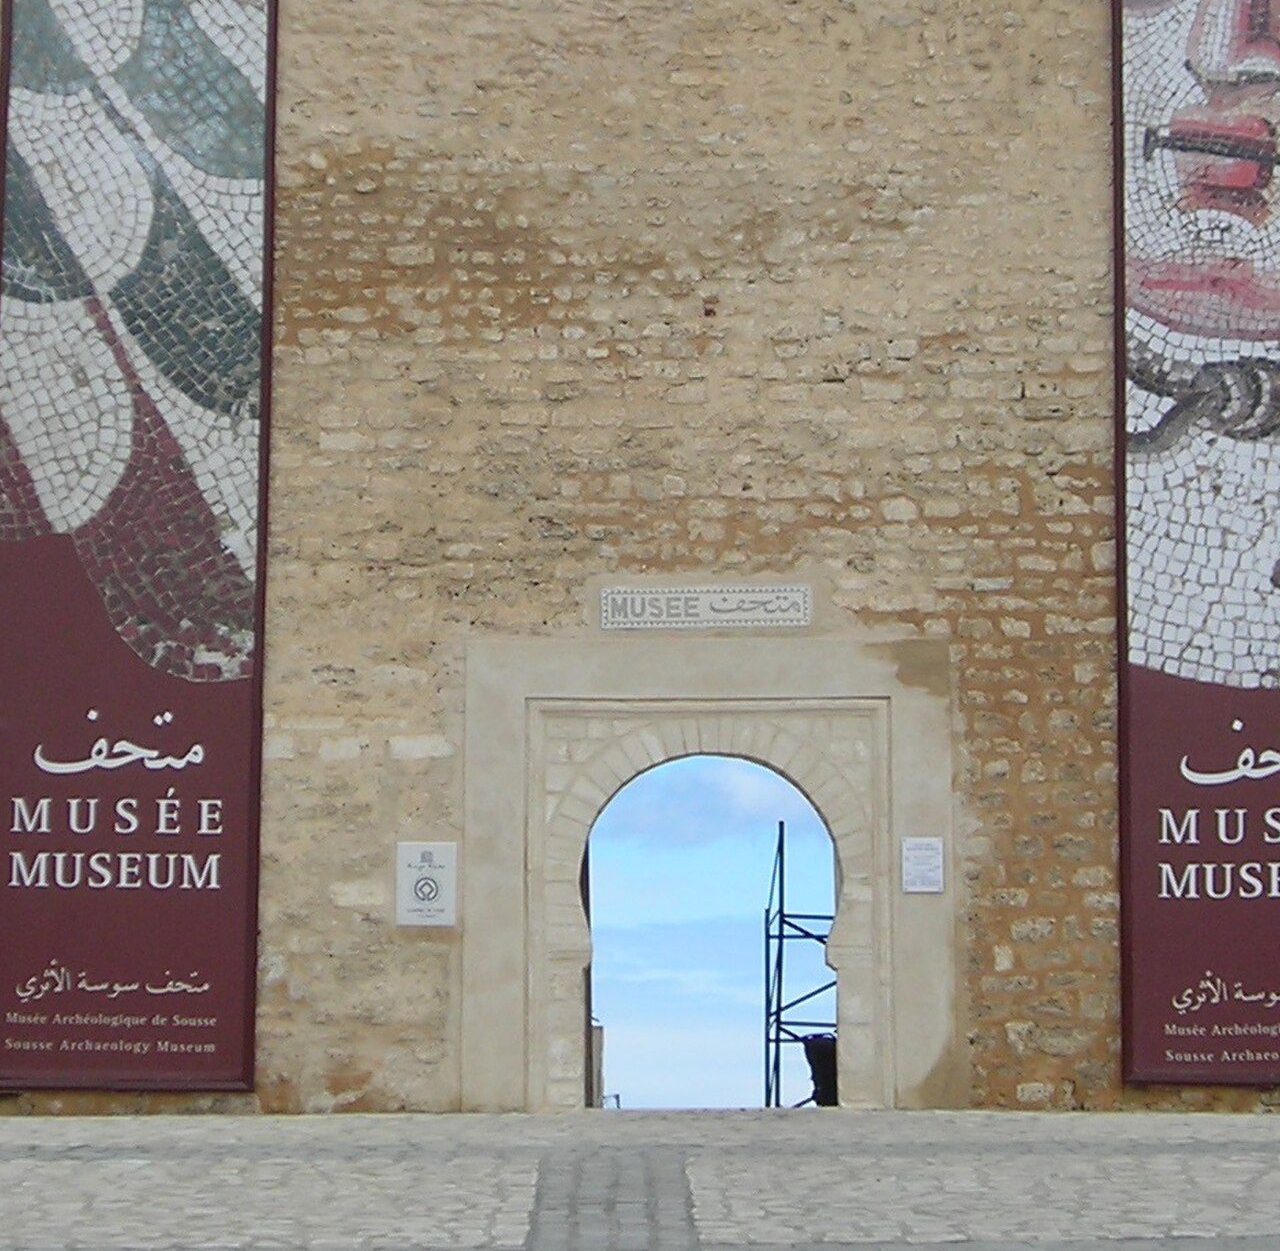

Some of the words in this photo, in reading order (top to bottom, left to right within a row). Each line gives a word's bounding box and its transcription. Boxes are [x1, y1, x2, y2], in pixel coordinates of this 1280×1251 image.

[610, 596, 701, 619] MUSEE
[709, 595, 801, 614] متحف
[33, 708, 205, 775] متحف
[9, 788, 223, 835] MUSÉE
[8, 852, 221, 889] MUSEUM
[15, 959, 71, 1003] الأثري
[77, 971, 140, 998] سوسة
[145, 970, 210, 994] متحف
[1172, 970, 1229, 1015] الأثري
[5, 1012, 47, 1025] Musée
[152, 1014, 167, 1026] de
[172, 1014, 217, 1027] Sousse
[1164, 1023, 1206, 1036] Musée
[4, 1037, 53, 1050] Sousse
[59, 1039, 150, 1054] Archaeology
[156, 1040, 216, 1053] Museum
[1165, 1050, 1214, 1062] Sousse
